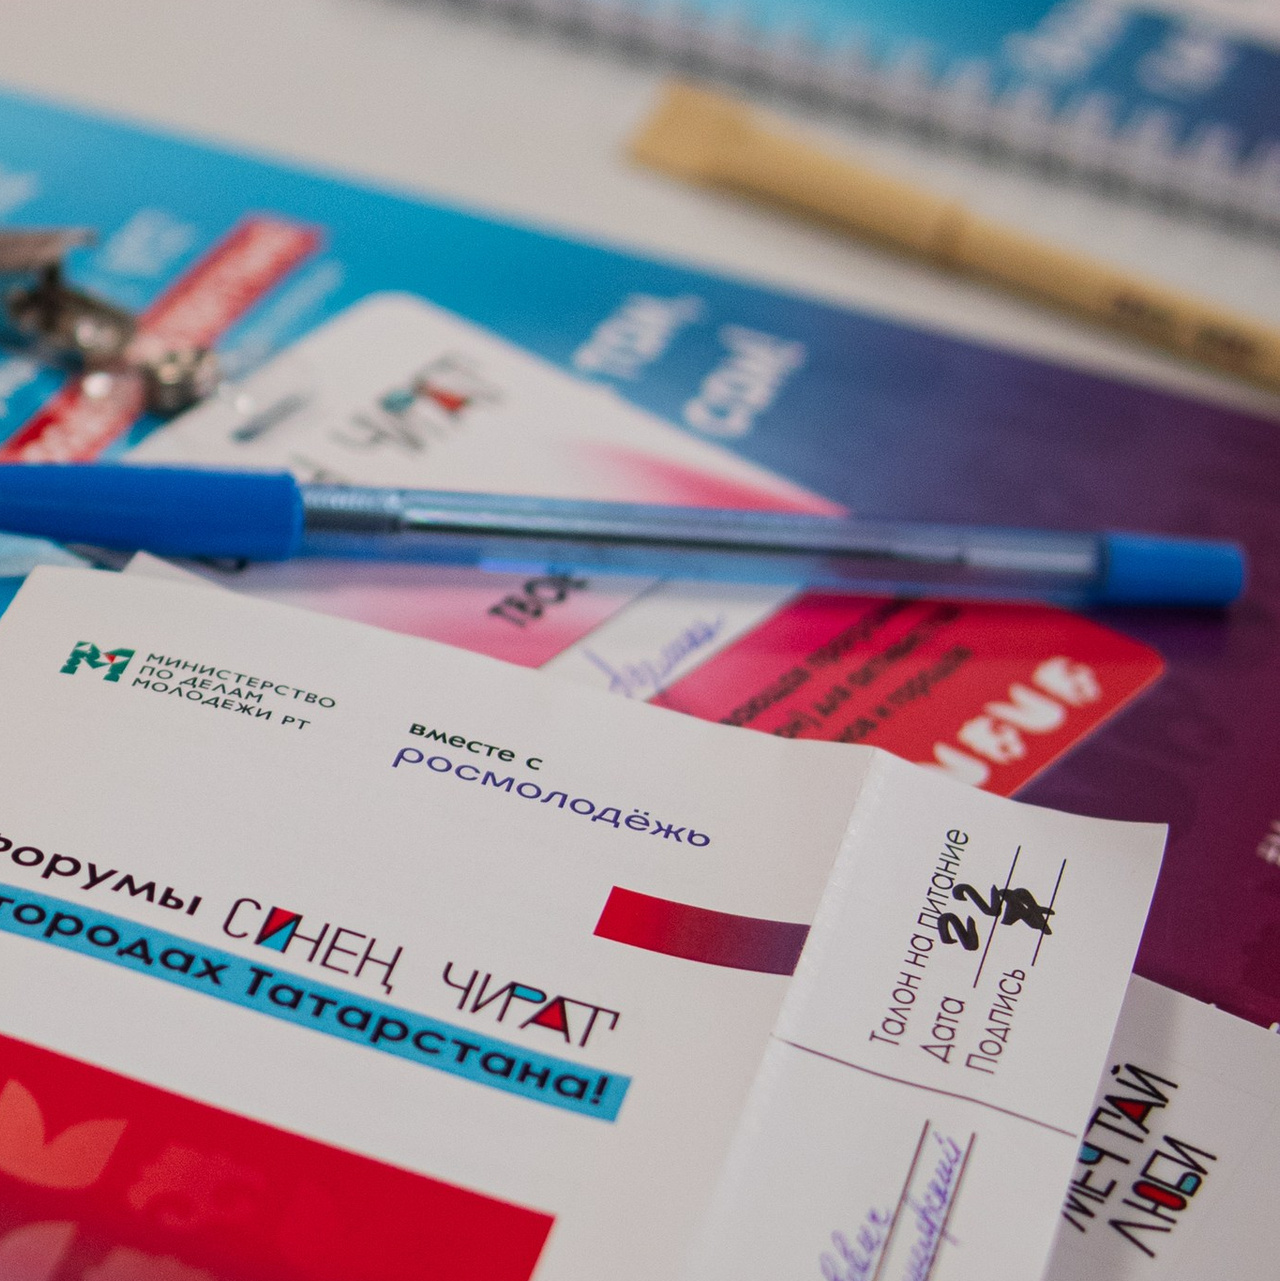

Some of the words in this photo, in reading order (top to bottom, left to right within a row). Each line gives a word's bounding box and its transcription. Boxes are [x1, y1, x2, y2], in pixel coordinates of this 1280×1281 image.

[131, 676, 273, 721] МОЛОДЕЖИ
[280, 714, 312, 732] РТ
[139, 664, 175, 682] ПО
[179, 673, 265, 704] ДЕЛАМ
[145, 652, 337, 709] МИНИСТЕРСТВО
[409, 721, 517, 764] вместе
[524, 756, 545, 772] с
[390, 745, 713, 850] росмолодёжь
[917, 828, 969, 930] питание
[904, 933, 935, 968] на
[245, 967, 611, 1109] Татарстана!
[440, 960, 621, 1049] ЧИРАТ
[869, 971, 922, 1046] Талон
[919, 996, 965, 1064] Дата
[965, 969, 1026, 1075] Подпись
[1108, 1134, 1218, 1258] ЛЮБИ
